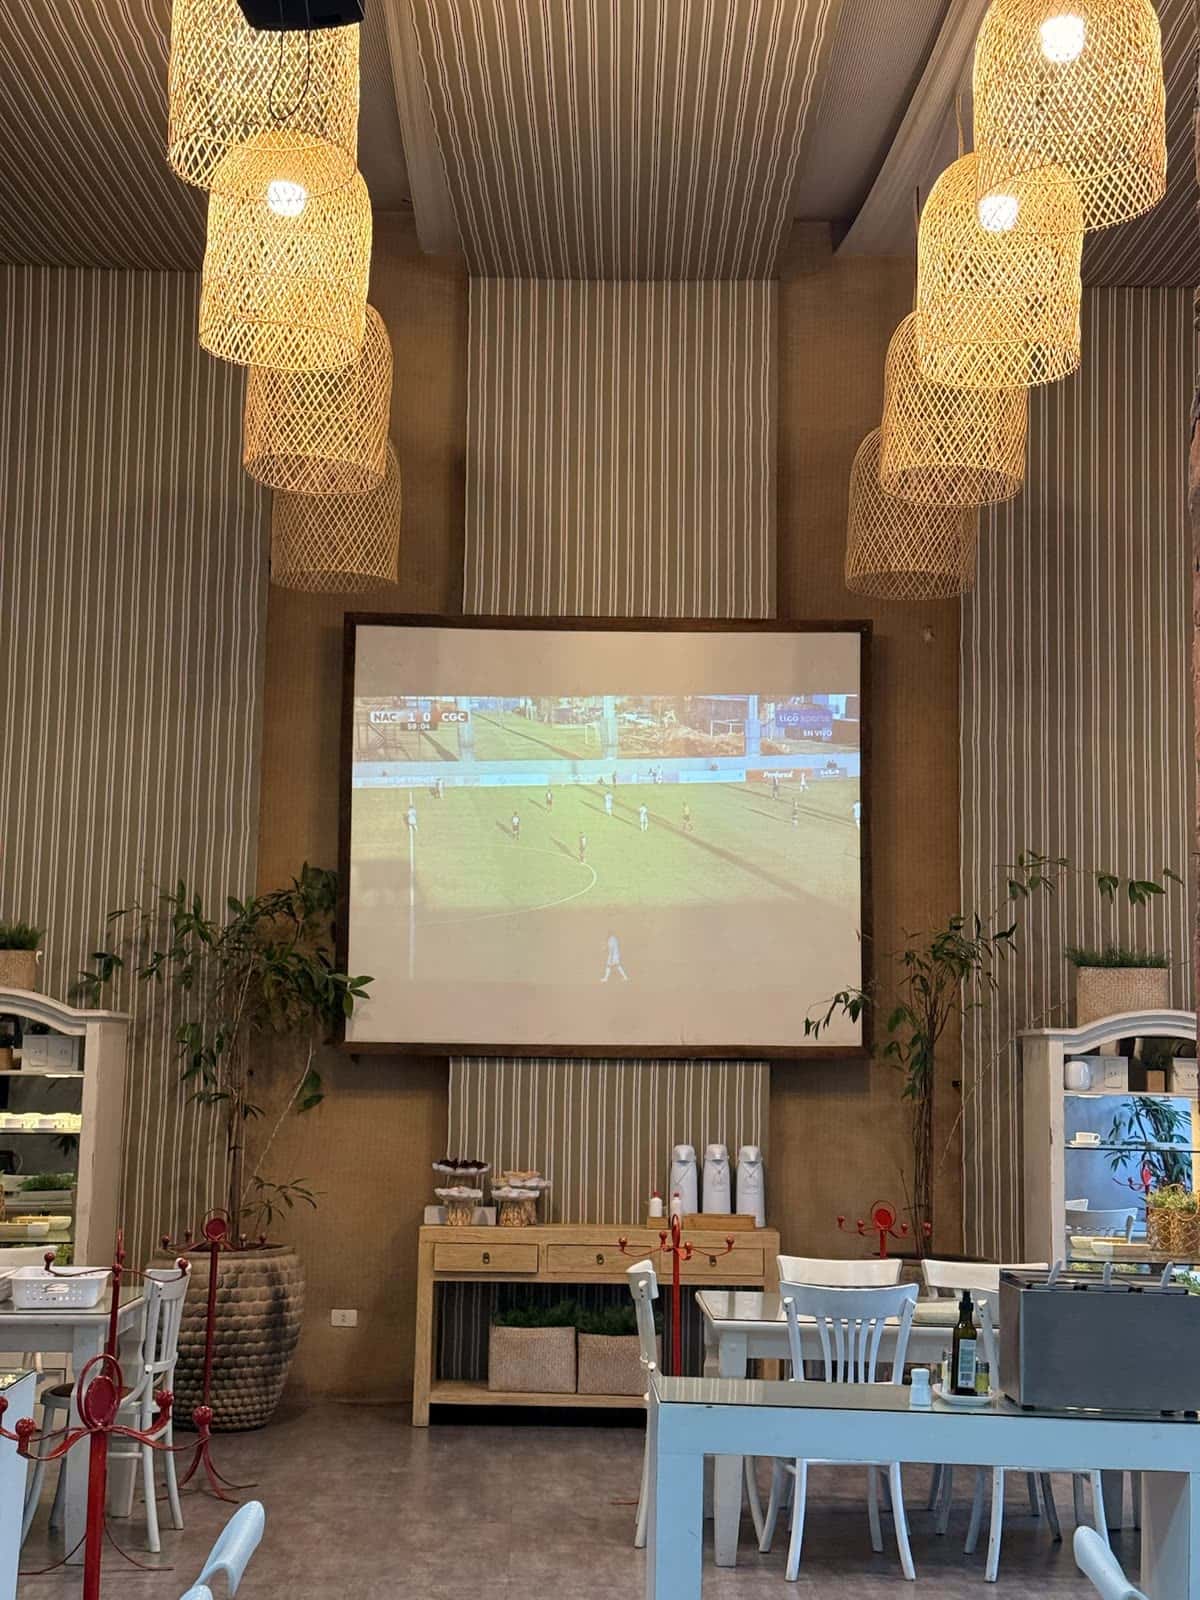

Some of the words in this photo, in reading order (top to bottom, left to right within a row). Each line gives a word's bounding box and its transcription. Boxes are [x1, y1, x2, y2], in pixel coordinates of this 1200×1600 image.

[374, 712, 398, 722] NAC
[408, 712, 416, 722] 1
[423, 712, 431, 722] 0
[441, 712, 465, 722] CGC
[814, 729, 833, 737] VIVO
